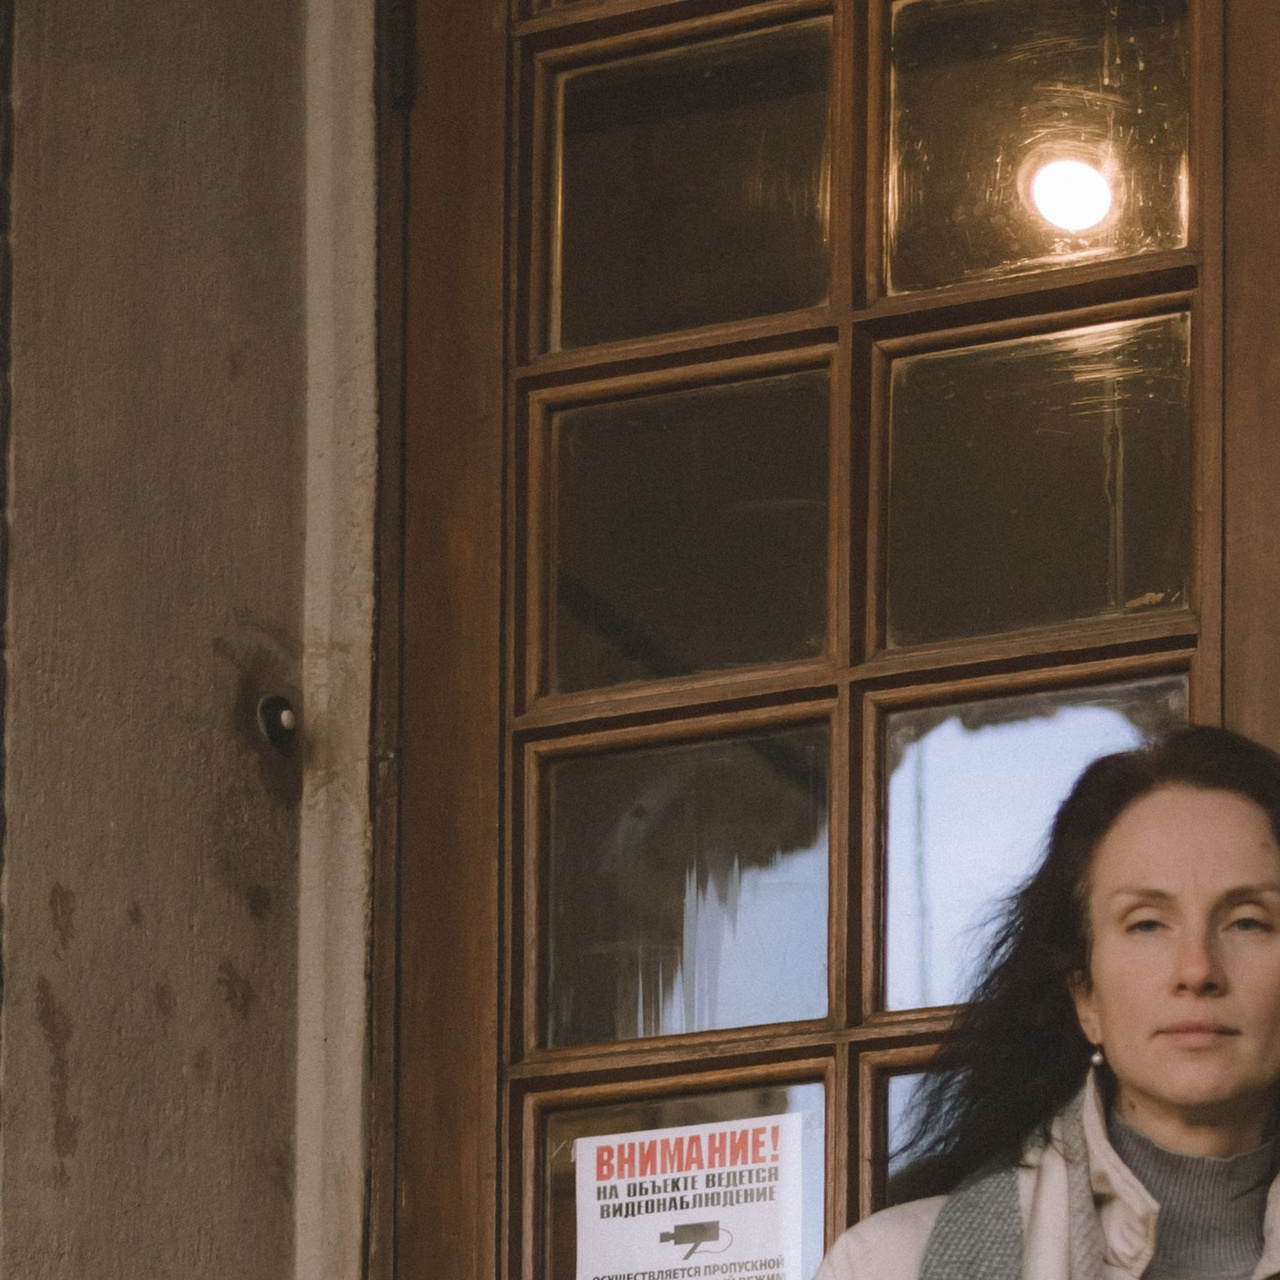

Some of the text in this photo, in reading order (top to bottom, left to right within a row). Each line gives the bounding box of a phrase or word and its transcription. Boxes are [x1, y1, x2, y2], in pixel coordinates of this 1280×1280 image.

[596, 1125, 780, 1181] ВНИМАНИЕ!
[596, 1166, 779, 1201] НА ОБЪЕКТЕ ВЕДЕТСЯ
[600, 1188, 776, 1219] ВИДЕОНАБЛЮДЕНИЕ
[704, 1255, 784, 1275] ПРОПУСКНОЙ
